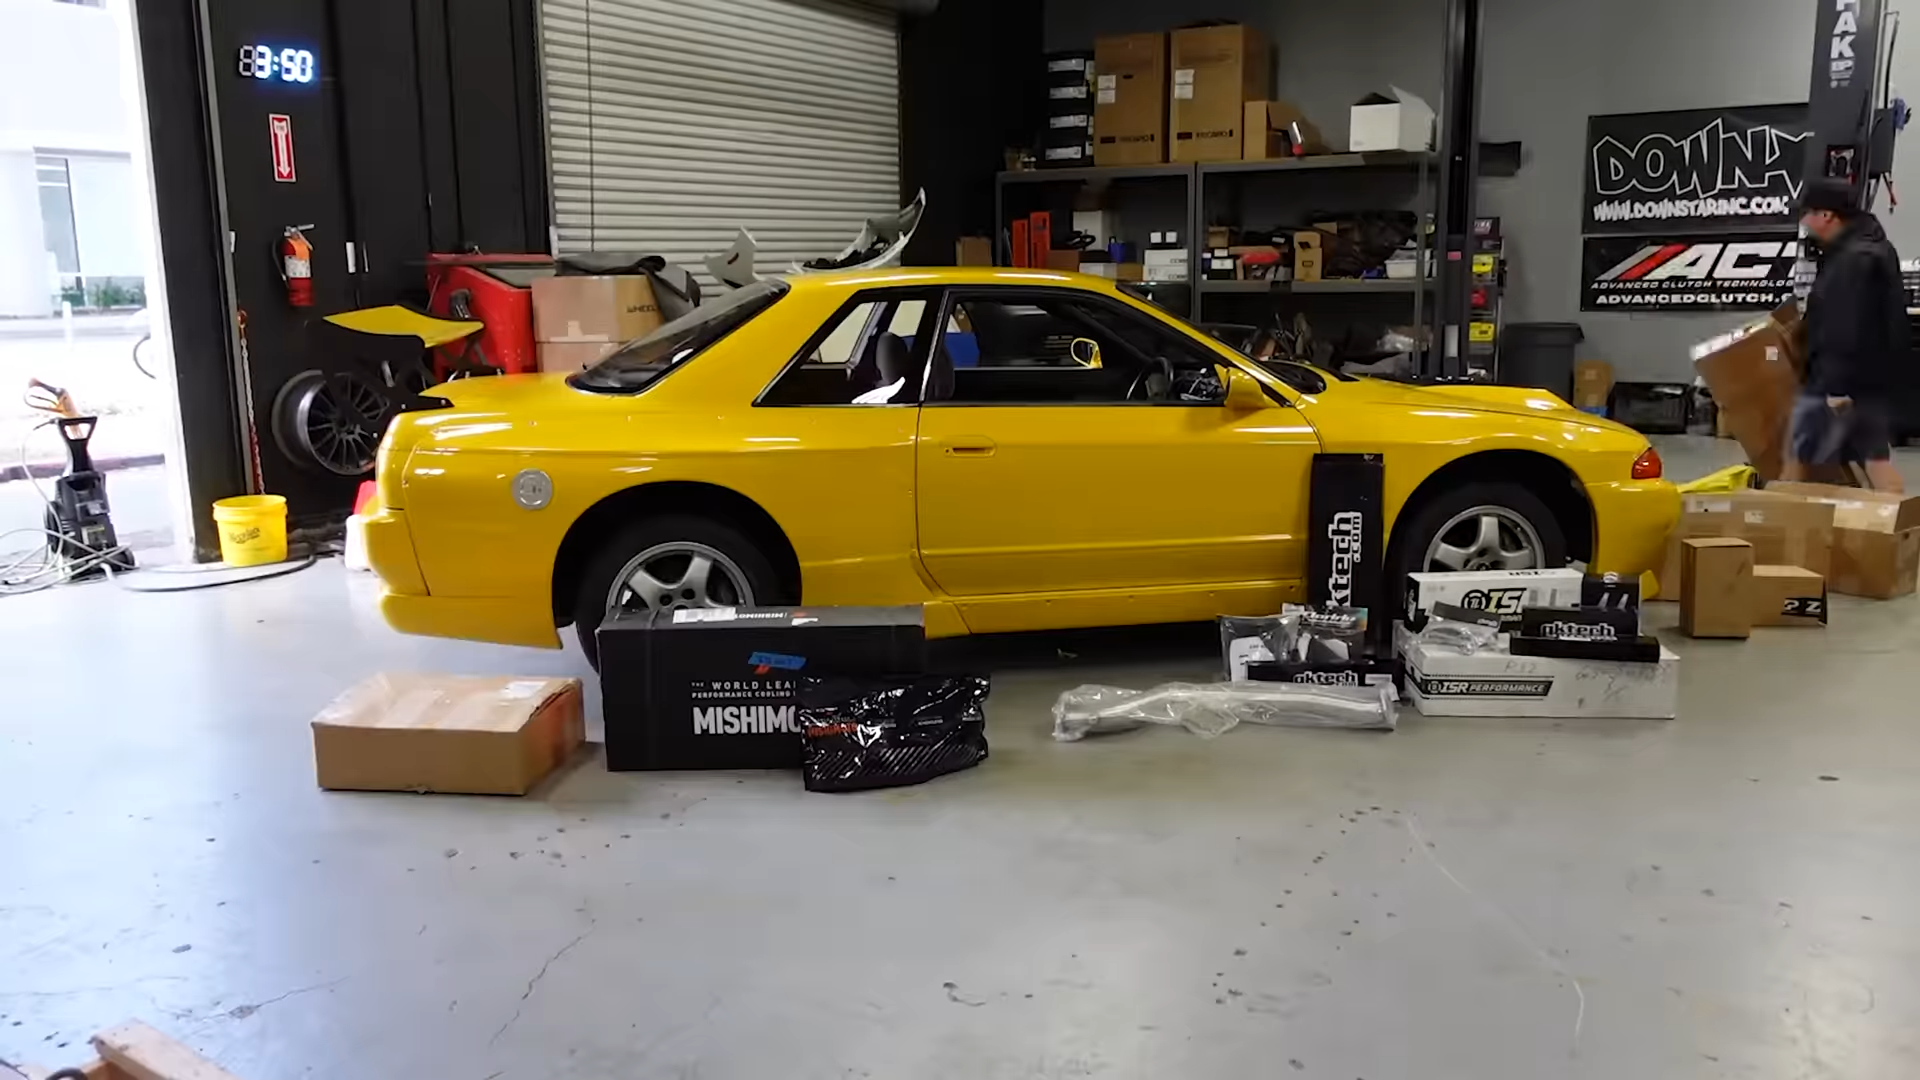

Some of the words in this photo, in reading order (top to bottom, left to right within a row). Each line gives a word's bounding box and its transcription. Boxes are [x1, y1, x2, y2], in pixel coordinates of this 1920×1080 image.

[255, 45, 313, 83] 3:50
[1591, 280, 1658, 289] ADVANCED
[1662, 280, 1712, 289] CLUTCH
[711, 681, 759, 690] WORLD
[1440, 682, 1469, 693] ISR
[1469, 684, 1545, 692] PERFORMANCE
